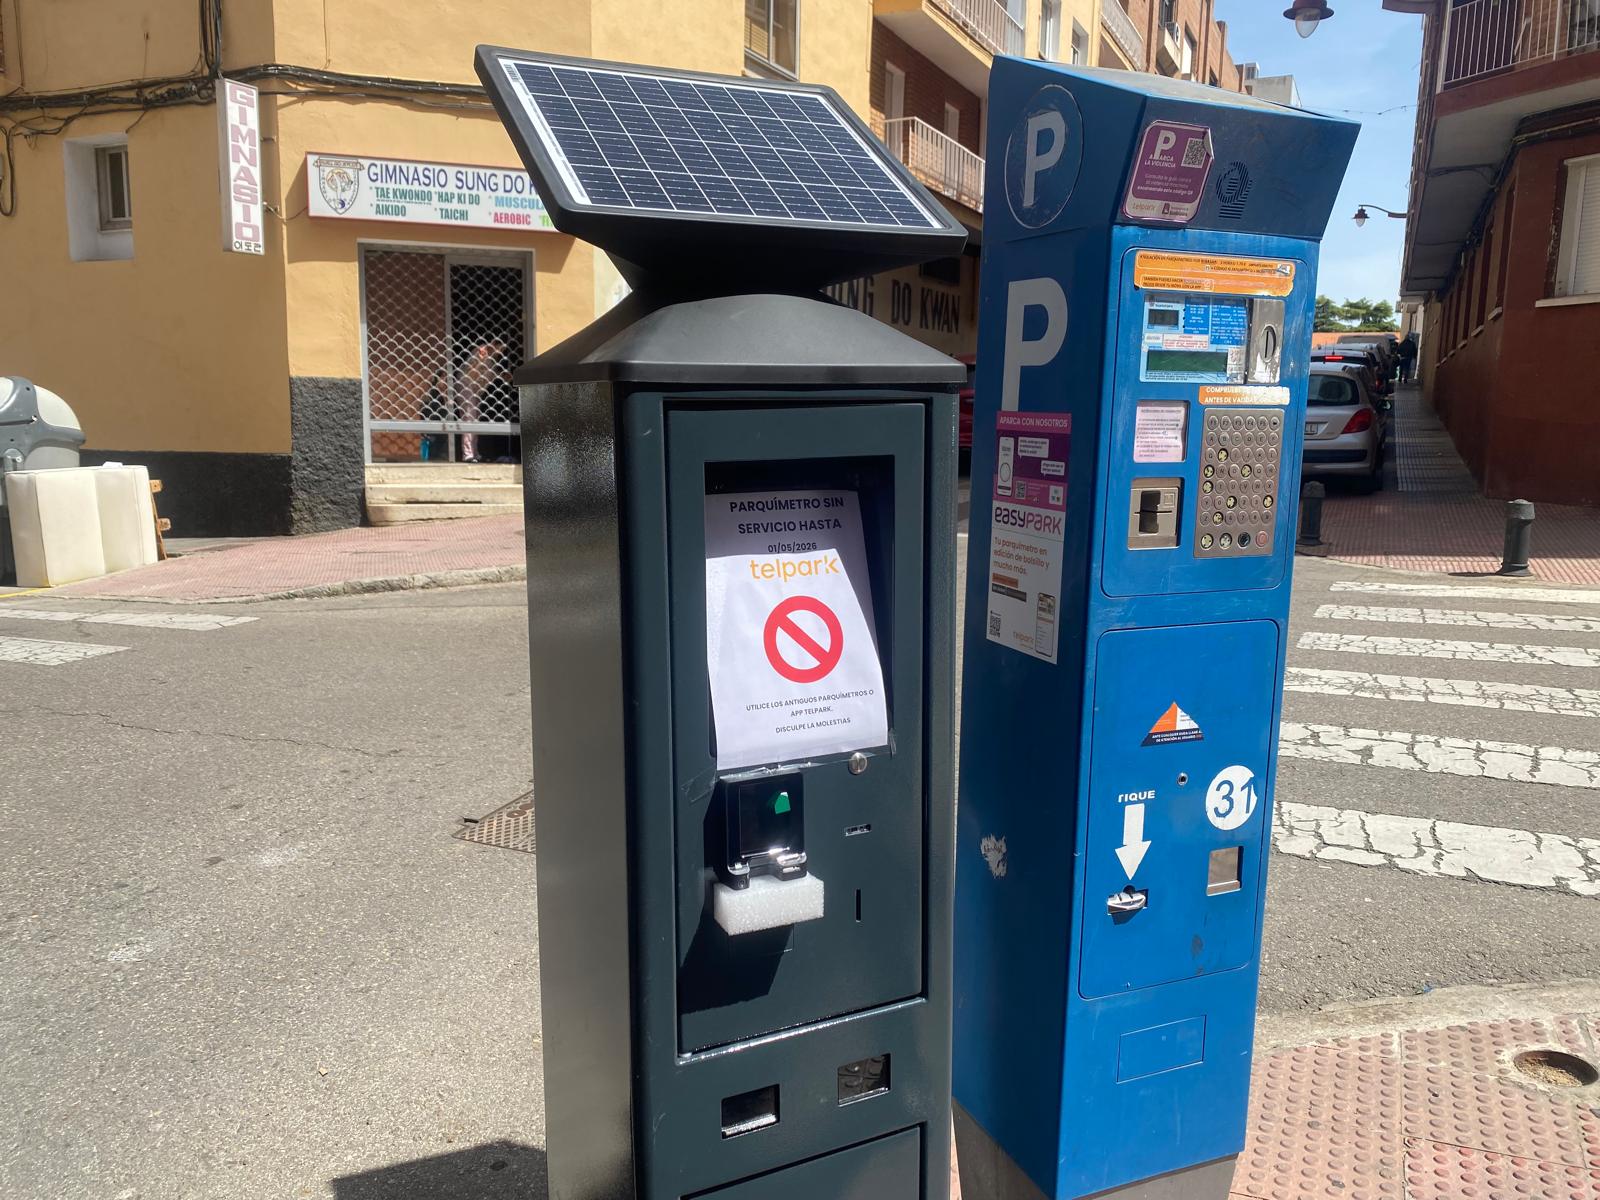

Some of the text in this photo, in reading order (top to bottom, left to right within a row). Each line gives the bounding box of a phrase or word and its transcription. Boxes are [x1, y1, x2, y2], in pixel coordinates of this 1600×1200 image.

[229, 84, 260, 242] GIMNASIO
[1023, 110, 1066, 209] P
[367, 162, 448, 188] GIMNASIO
[455, 170, 498, 192] SUNG
[503, 174, 524, 194] DO
[375, 187, 390, 199] TAE
[392, 188, 432, 202] KWONDO
[438, 191, 455, 204] HAP
[457, 192, 466, 205] KI
[468, 193, 480, 206] DO
[375, 204, 406, 217] AIKIDO
[439, 207, 468, 221] TAICHI
[493, 212, 531, 225] AEROBIC
[891, 278, 912, 326] DO
[920, 286, 960, 334] KWAN
[1001, 277, 1068, 412] P
[1000, 416, 1068, 428] APARCA CON NOSOTROS
[729, 496, 844, 513] PARQUÍMETRO SIN
[738, 518, 842, 535] SERVICIO HASTA
[767, 542, 818, 553] 01/05/2026
[750, 555, 839, 583] telpark
[993, 560, 1013, 572] mucho
[1014, 553, 1023, 561] de
[1023, 554, 1045, 568] bolsillo
[746, 703, 770, 712] UTILICE
[784, 697, 817, 707] ANTIGUOS
[818, 690, 868, 703] PARQUÍMETROS
[790, 709, 803, 717] APP
[776, 723, 806, 734] DISCULPE
[815, 718, 851, 728] MOLESTIAS
